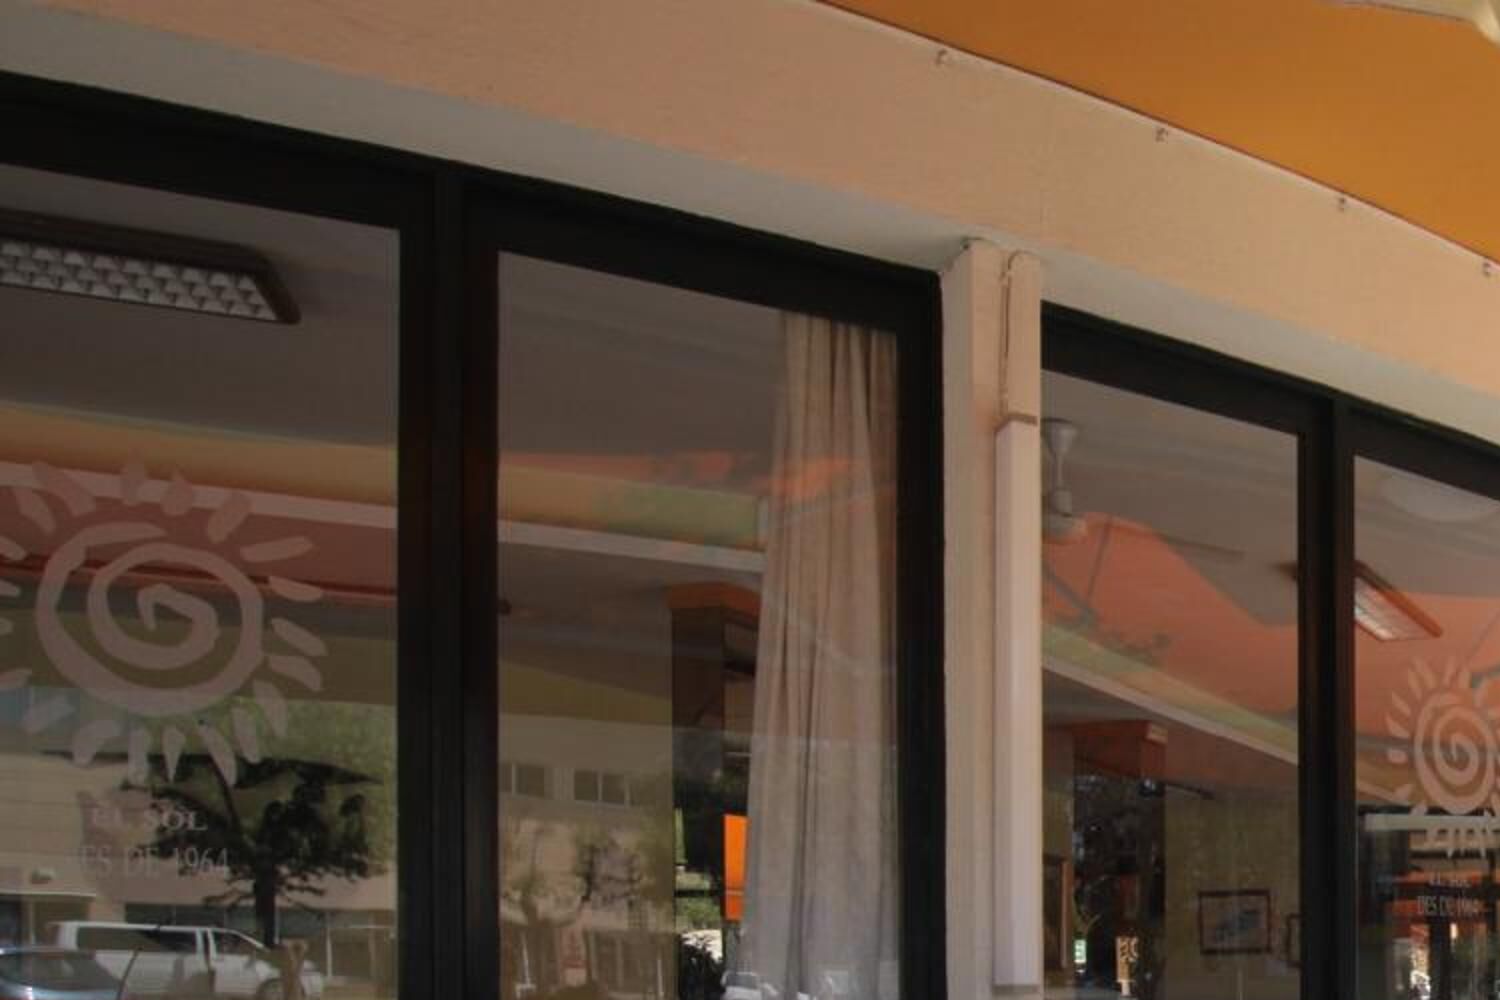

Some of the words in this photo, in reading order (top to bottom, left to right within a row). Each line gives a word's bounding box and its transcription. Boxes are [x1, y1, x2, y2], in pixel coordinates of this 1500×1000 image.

[143, 808, 208, 832] SOL
[67, 846, 113, 878] ES
[174, 846, 232, 882] 1964
